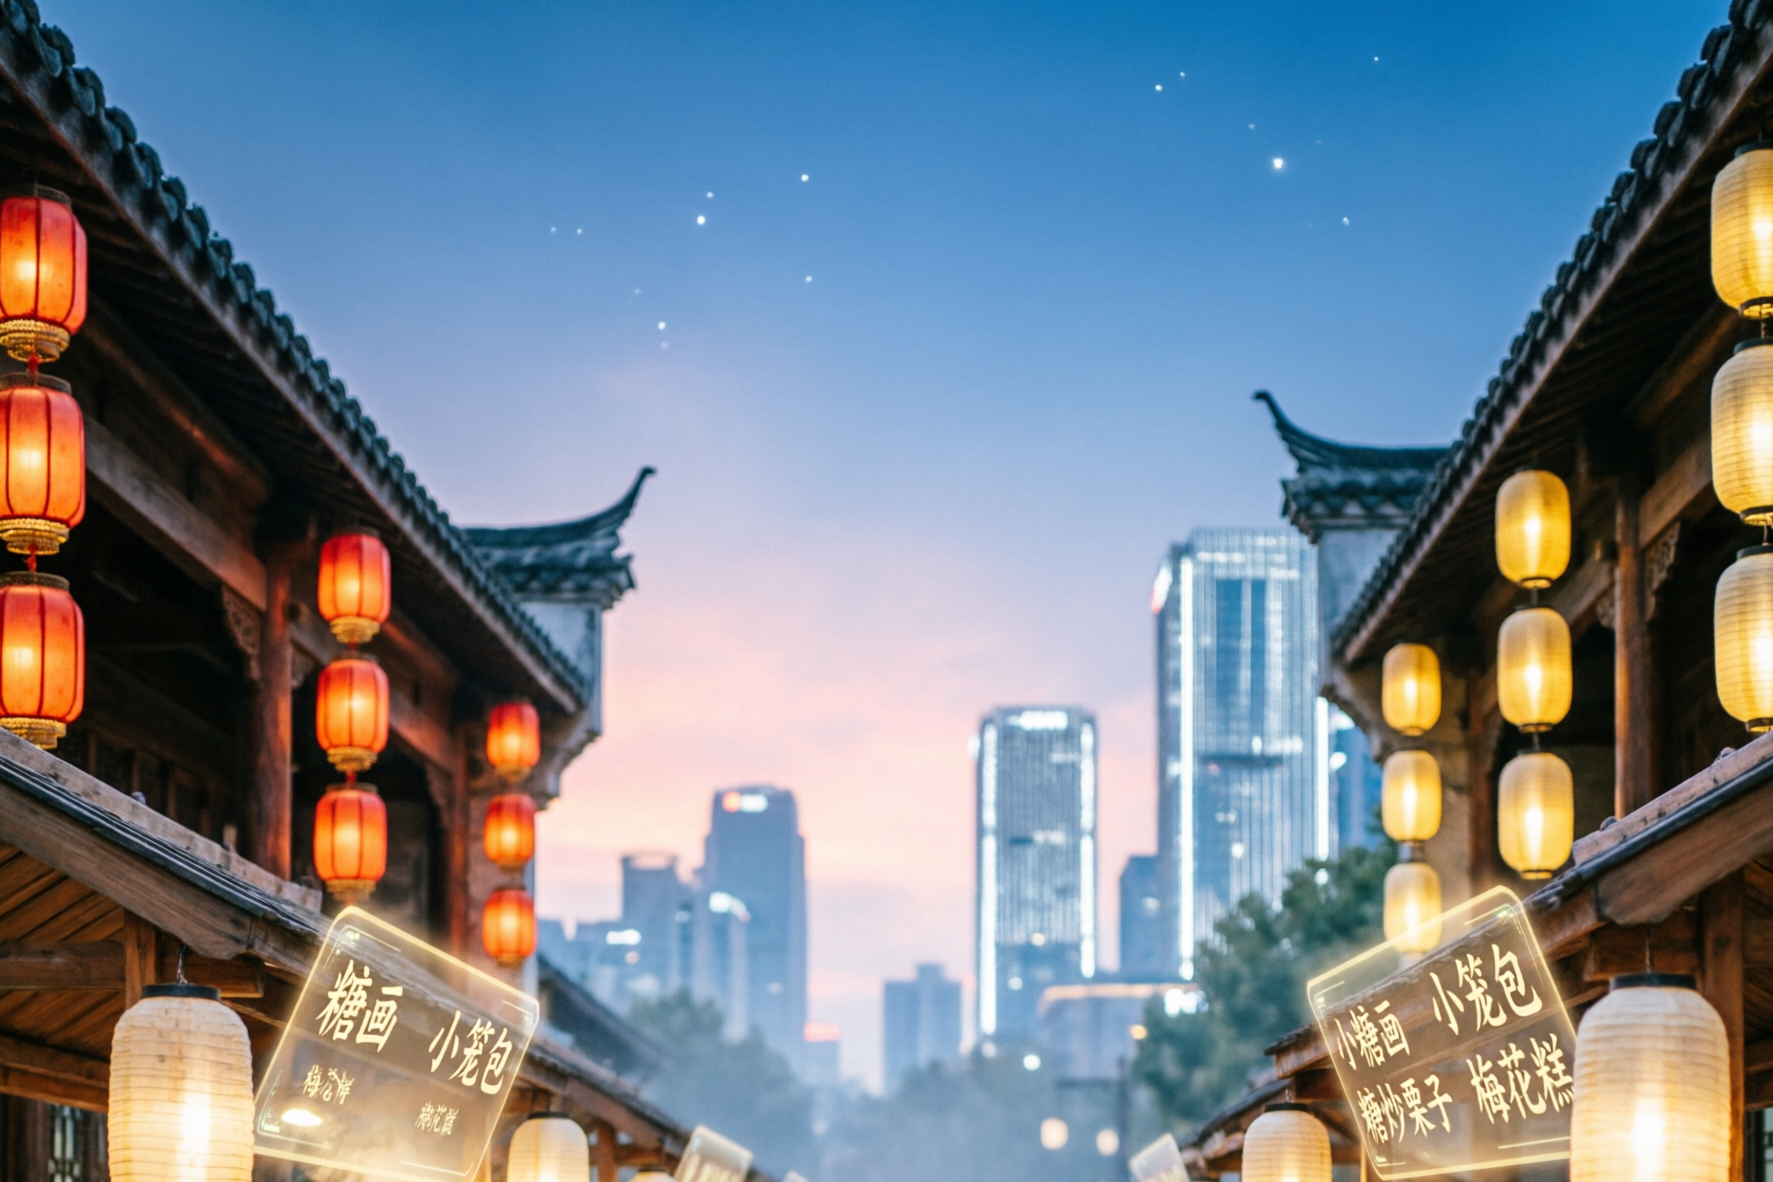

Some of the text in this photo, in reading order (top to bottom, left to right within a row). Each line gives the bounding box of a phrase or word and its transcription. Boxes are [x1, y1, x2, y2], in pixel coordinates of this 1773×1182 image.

[316, 960, 403, 1053] 糖画
[428, 1010, 514, 1095] 小笼包
[1333, 944, 1543, 1070] 小糖画 小笼包
[1357, 1033, 1574, 1144] 糖炒栗子 梅花糕
